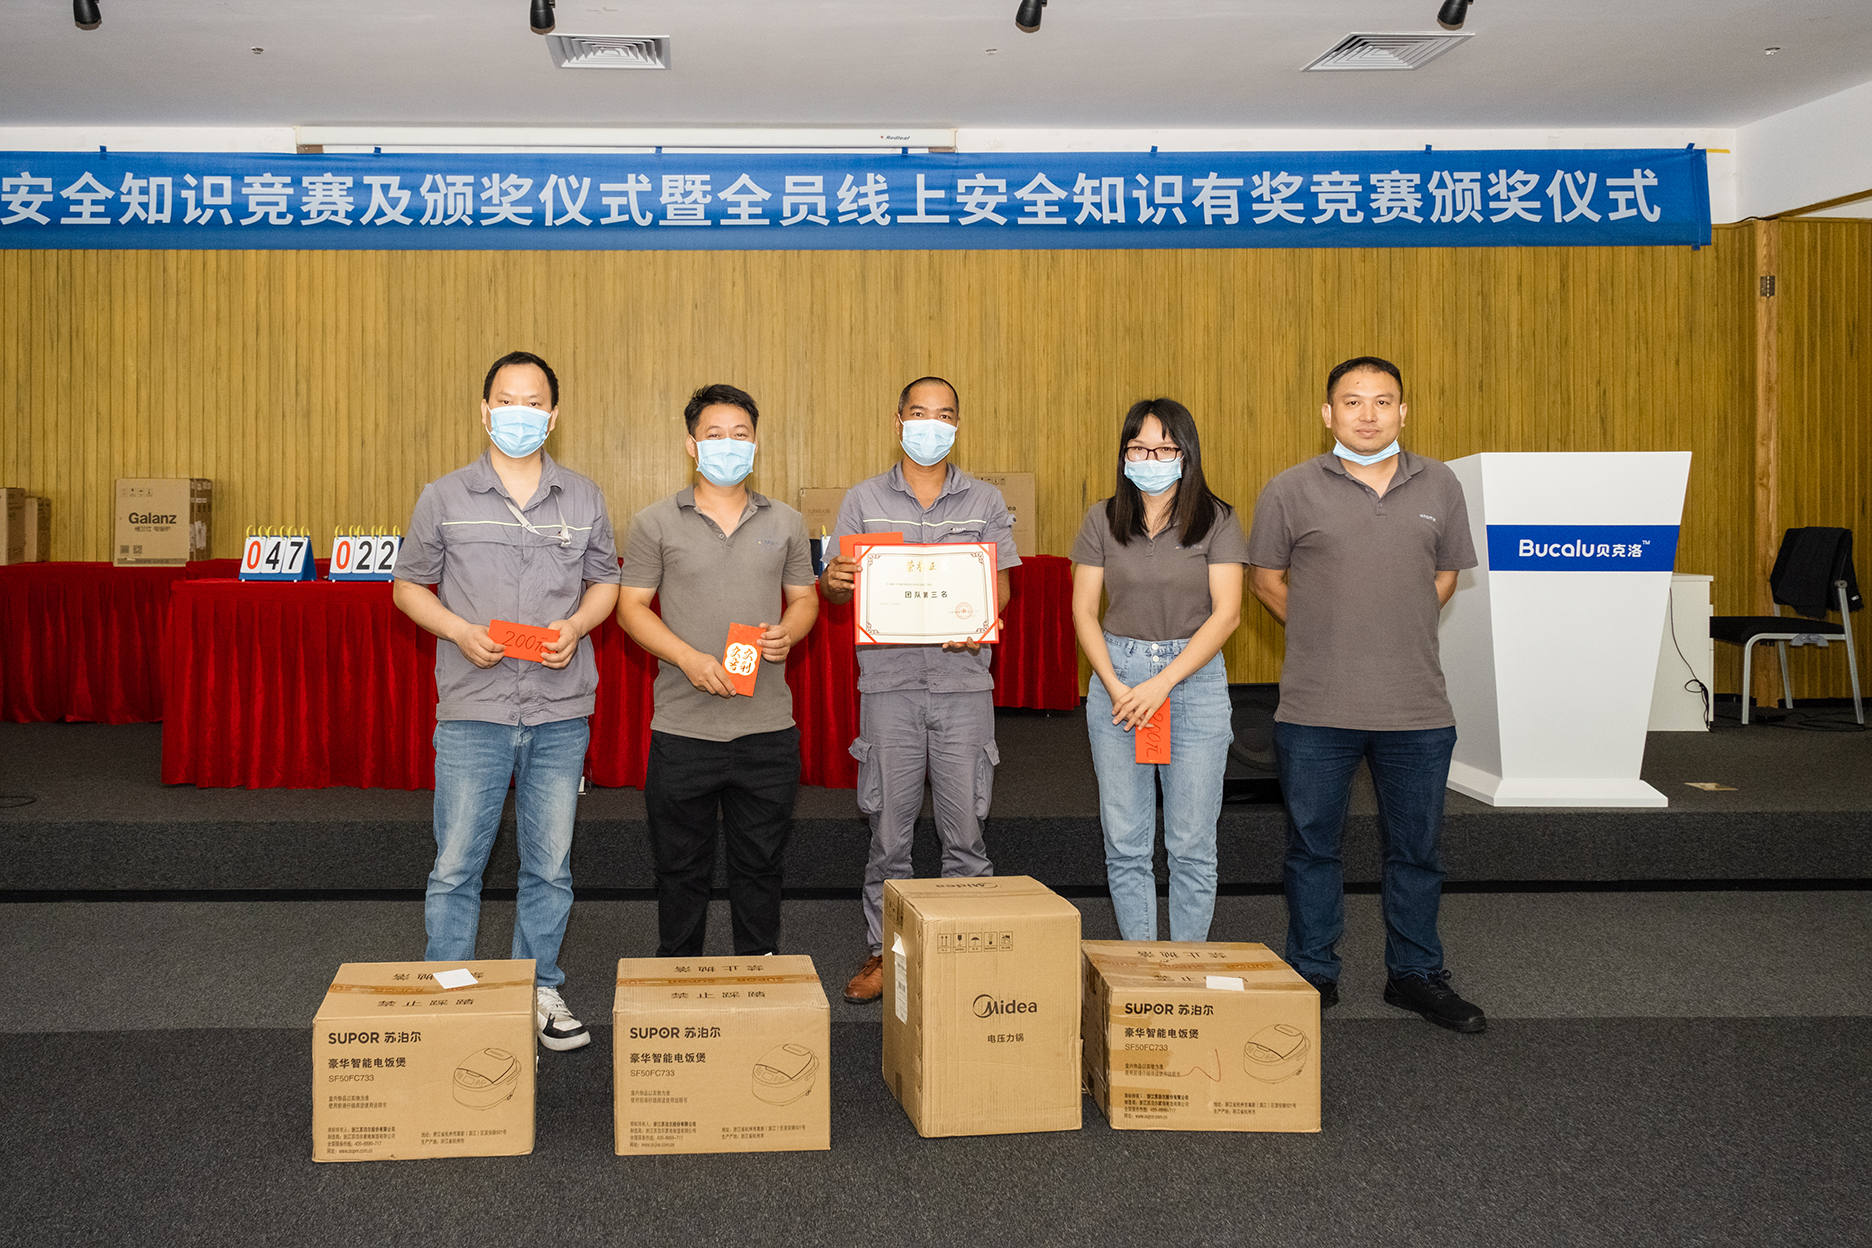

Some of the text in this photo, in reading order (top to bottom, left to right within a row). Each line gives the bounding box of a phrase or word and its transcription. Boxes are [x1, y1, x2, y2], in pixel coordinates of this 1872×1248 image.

[1, 168, 1661, 226] 安全知识竞赛及颁奖仪式暨全员线上安全知识有奖竞赛颁奖仪式
[128, 512, 177, 524] Galanz
[1518, 539, 1595, 557] Bucalu
[1596, 543, 1642, 558] 贝克洛
[246, 540, 304, 571] 047
[336, 541, 395, 570] 022
[905, 591, 948, 599] 团队第三名
[975, 995, 1038, 1018] Midea
[1125, 1002, 1214, 1016] SUPOR 苏泊尔
[328, 1031, 422, 1044] SUPOR 苏泊尔
[630, 1026, 721, 1040] SUPOR 苏泊尔
[987, 1033, 1024, 1043] 电压力锅
[1124, 1027, 1199, 1039] 豪华智能电饭煲
[1124, 1043, 1169, 1052] SF50FC733
[328, 1057, 407, 1069] 豪华智能电饭煲
[630, 1052, 706, 1064] 豪华智能电饭煲
[328, 1074, 375, 1083] SF50FC733
[630, 1069, 675, 1077] SF50FC733
